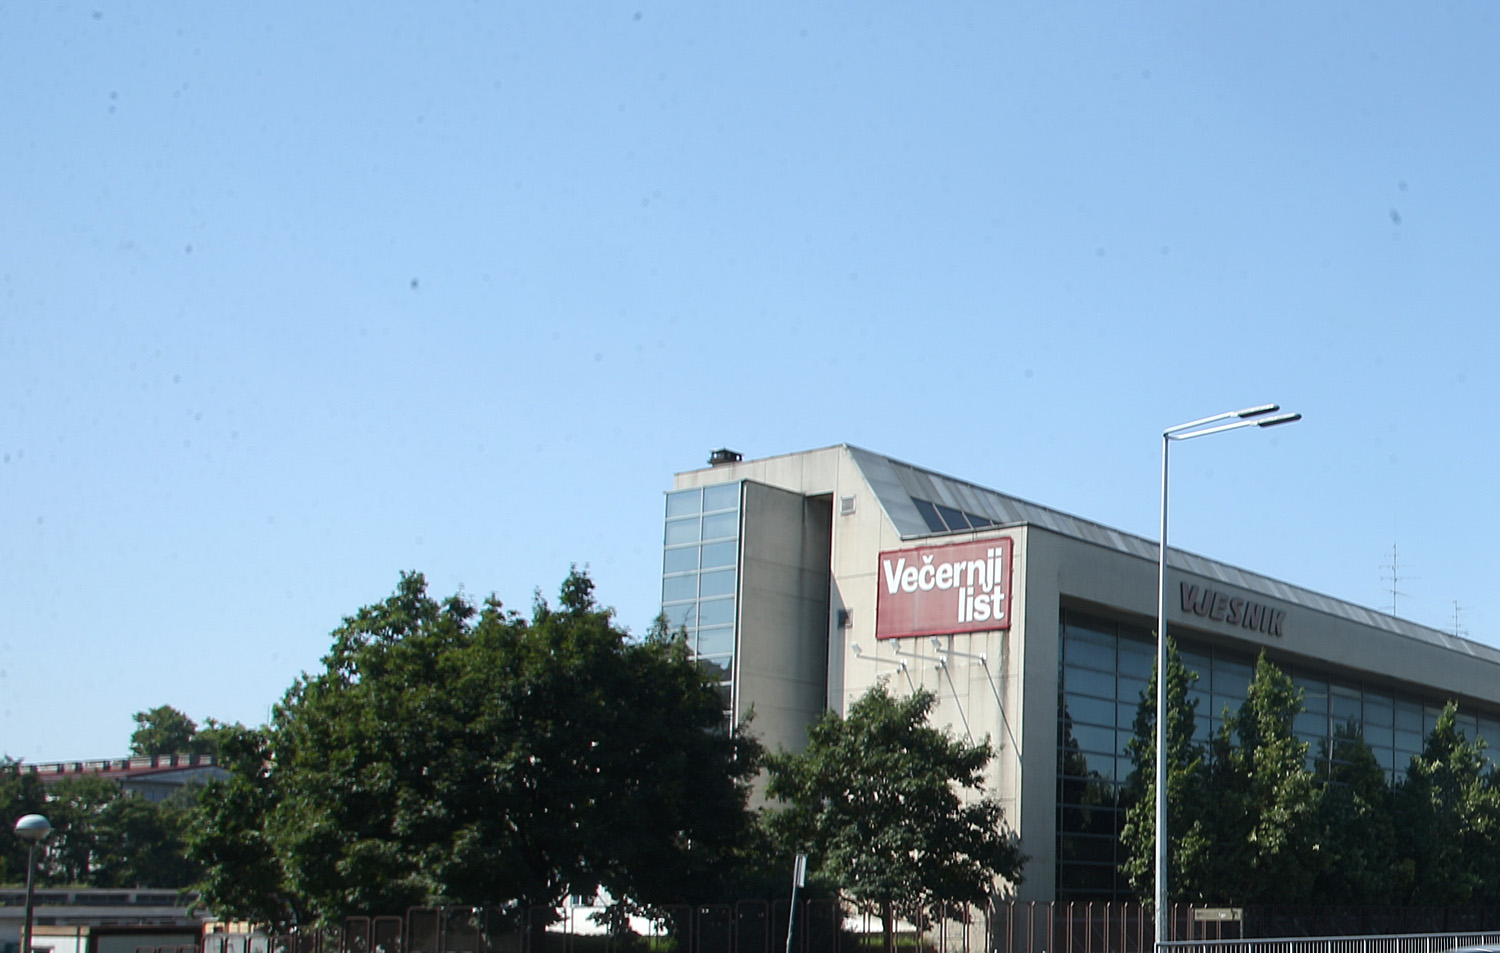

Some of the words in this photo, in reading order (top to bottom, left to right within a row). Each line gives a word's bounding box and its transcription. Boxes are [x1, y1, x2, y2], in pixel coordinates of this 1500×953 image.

[883, 547, 1003, 595] Večernji
[957, 585, 1005, 623] list
[1180, 581, 1287, 637] VJESNIK
